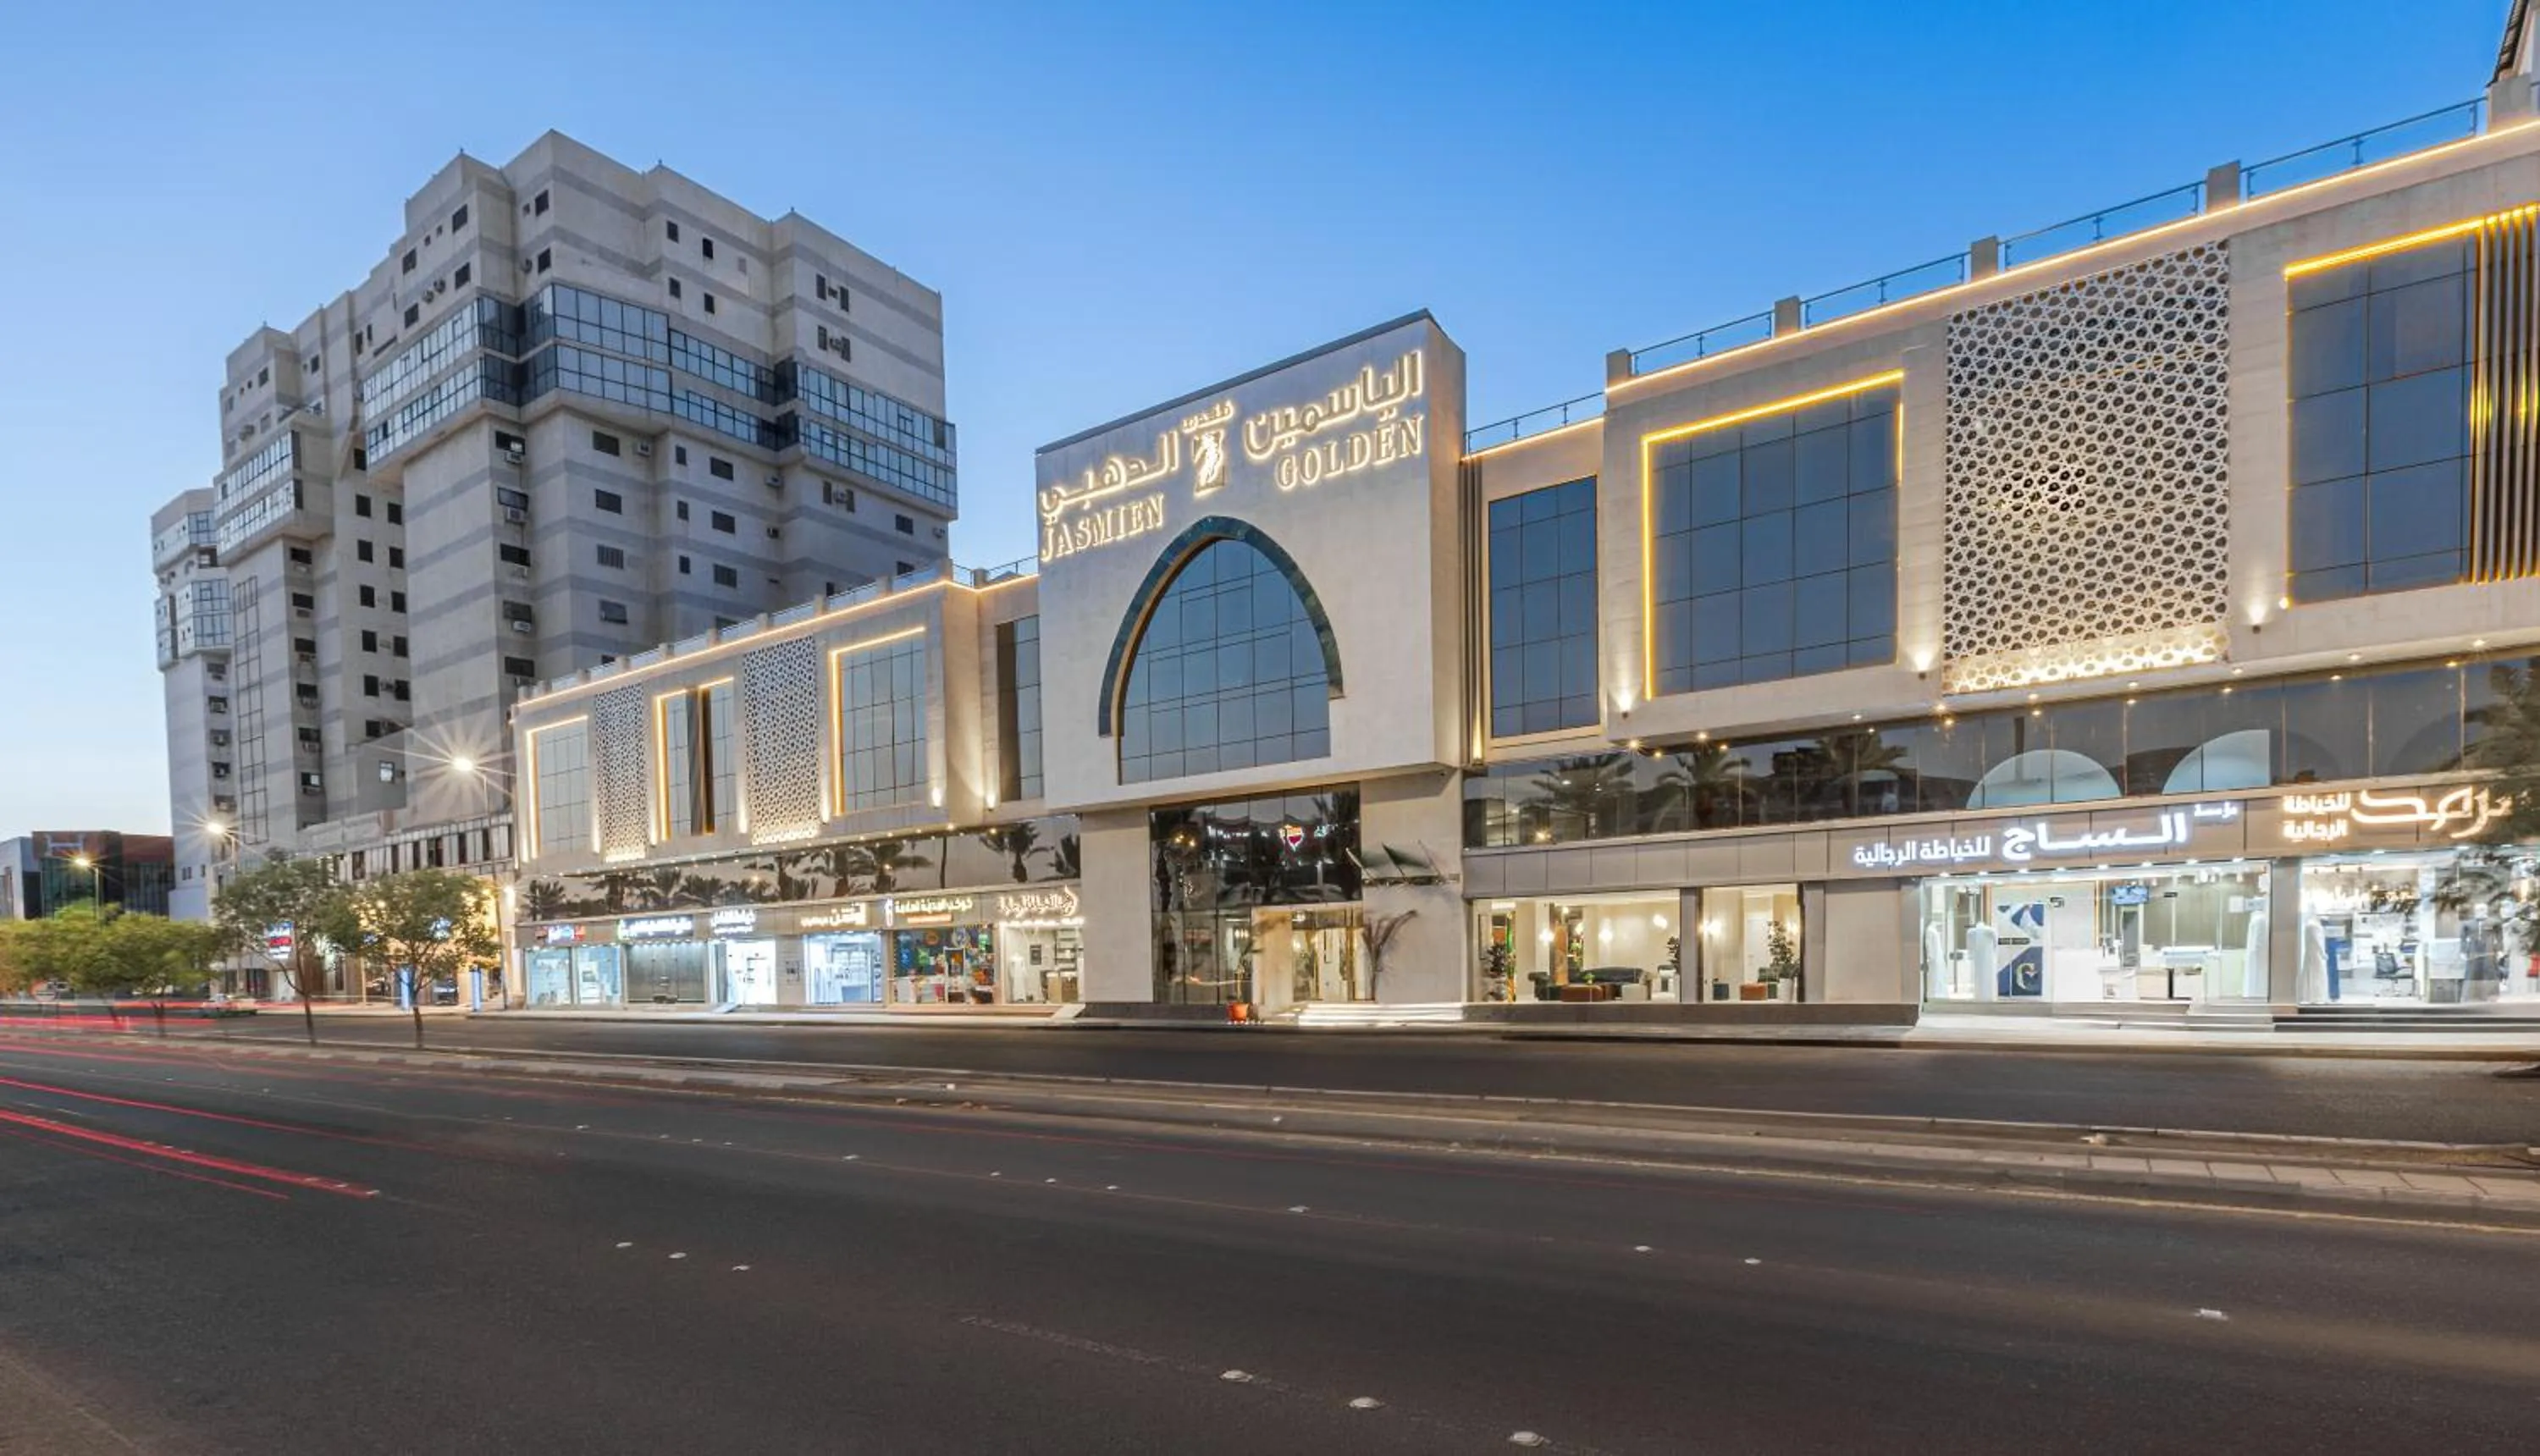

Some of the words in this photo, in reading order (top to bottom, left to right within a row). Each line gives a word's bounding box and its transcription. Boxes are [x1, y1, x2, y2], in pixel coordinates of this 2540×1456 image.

[1243, 349, 1422, 460] الياسمين
[1041, 494, 1165, 562] JASMIEN
[1276, 415, 1424, 491] GOLDEN
[2282, 791, 2351, 815] للخياطة
[2002, 811, 2188, 861] الساج
[2282, 819, 2349, 843] الرجالية
[1854, 840, 1917, 867] الرجالية
[1919, 836, 1991, 862] للخياطة
